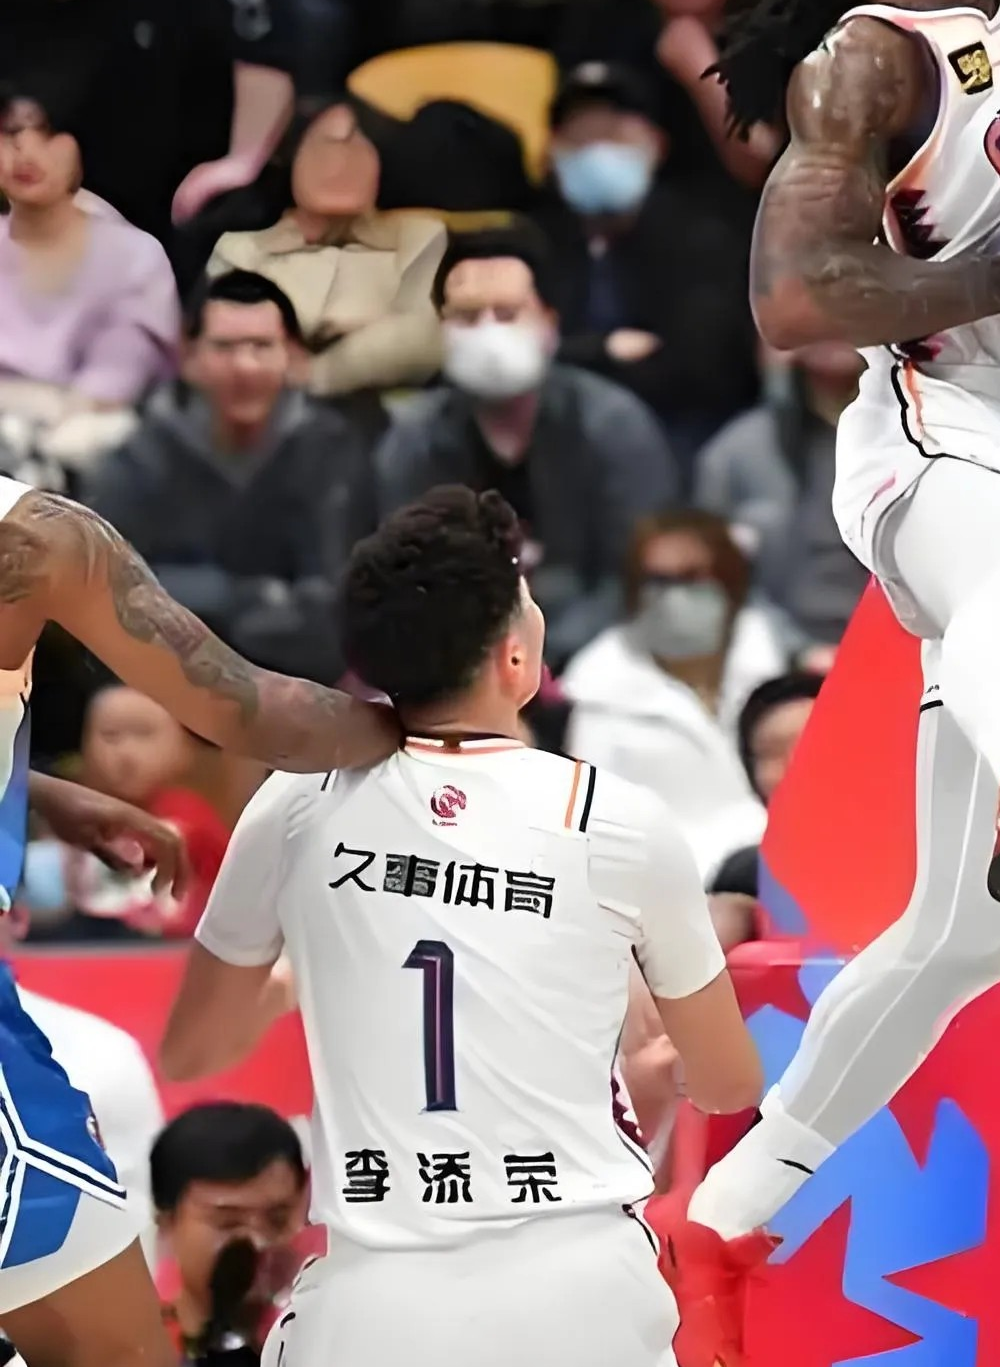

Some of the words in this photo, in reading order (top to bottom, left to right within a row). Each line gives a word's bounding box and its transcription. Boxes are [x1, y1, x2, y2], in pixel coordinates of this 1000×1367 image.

[402, 939, 460, 1112] 1
[342, 1149, 562, 1204] 李添荣
